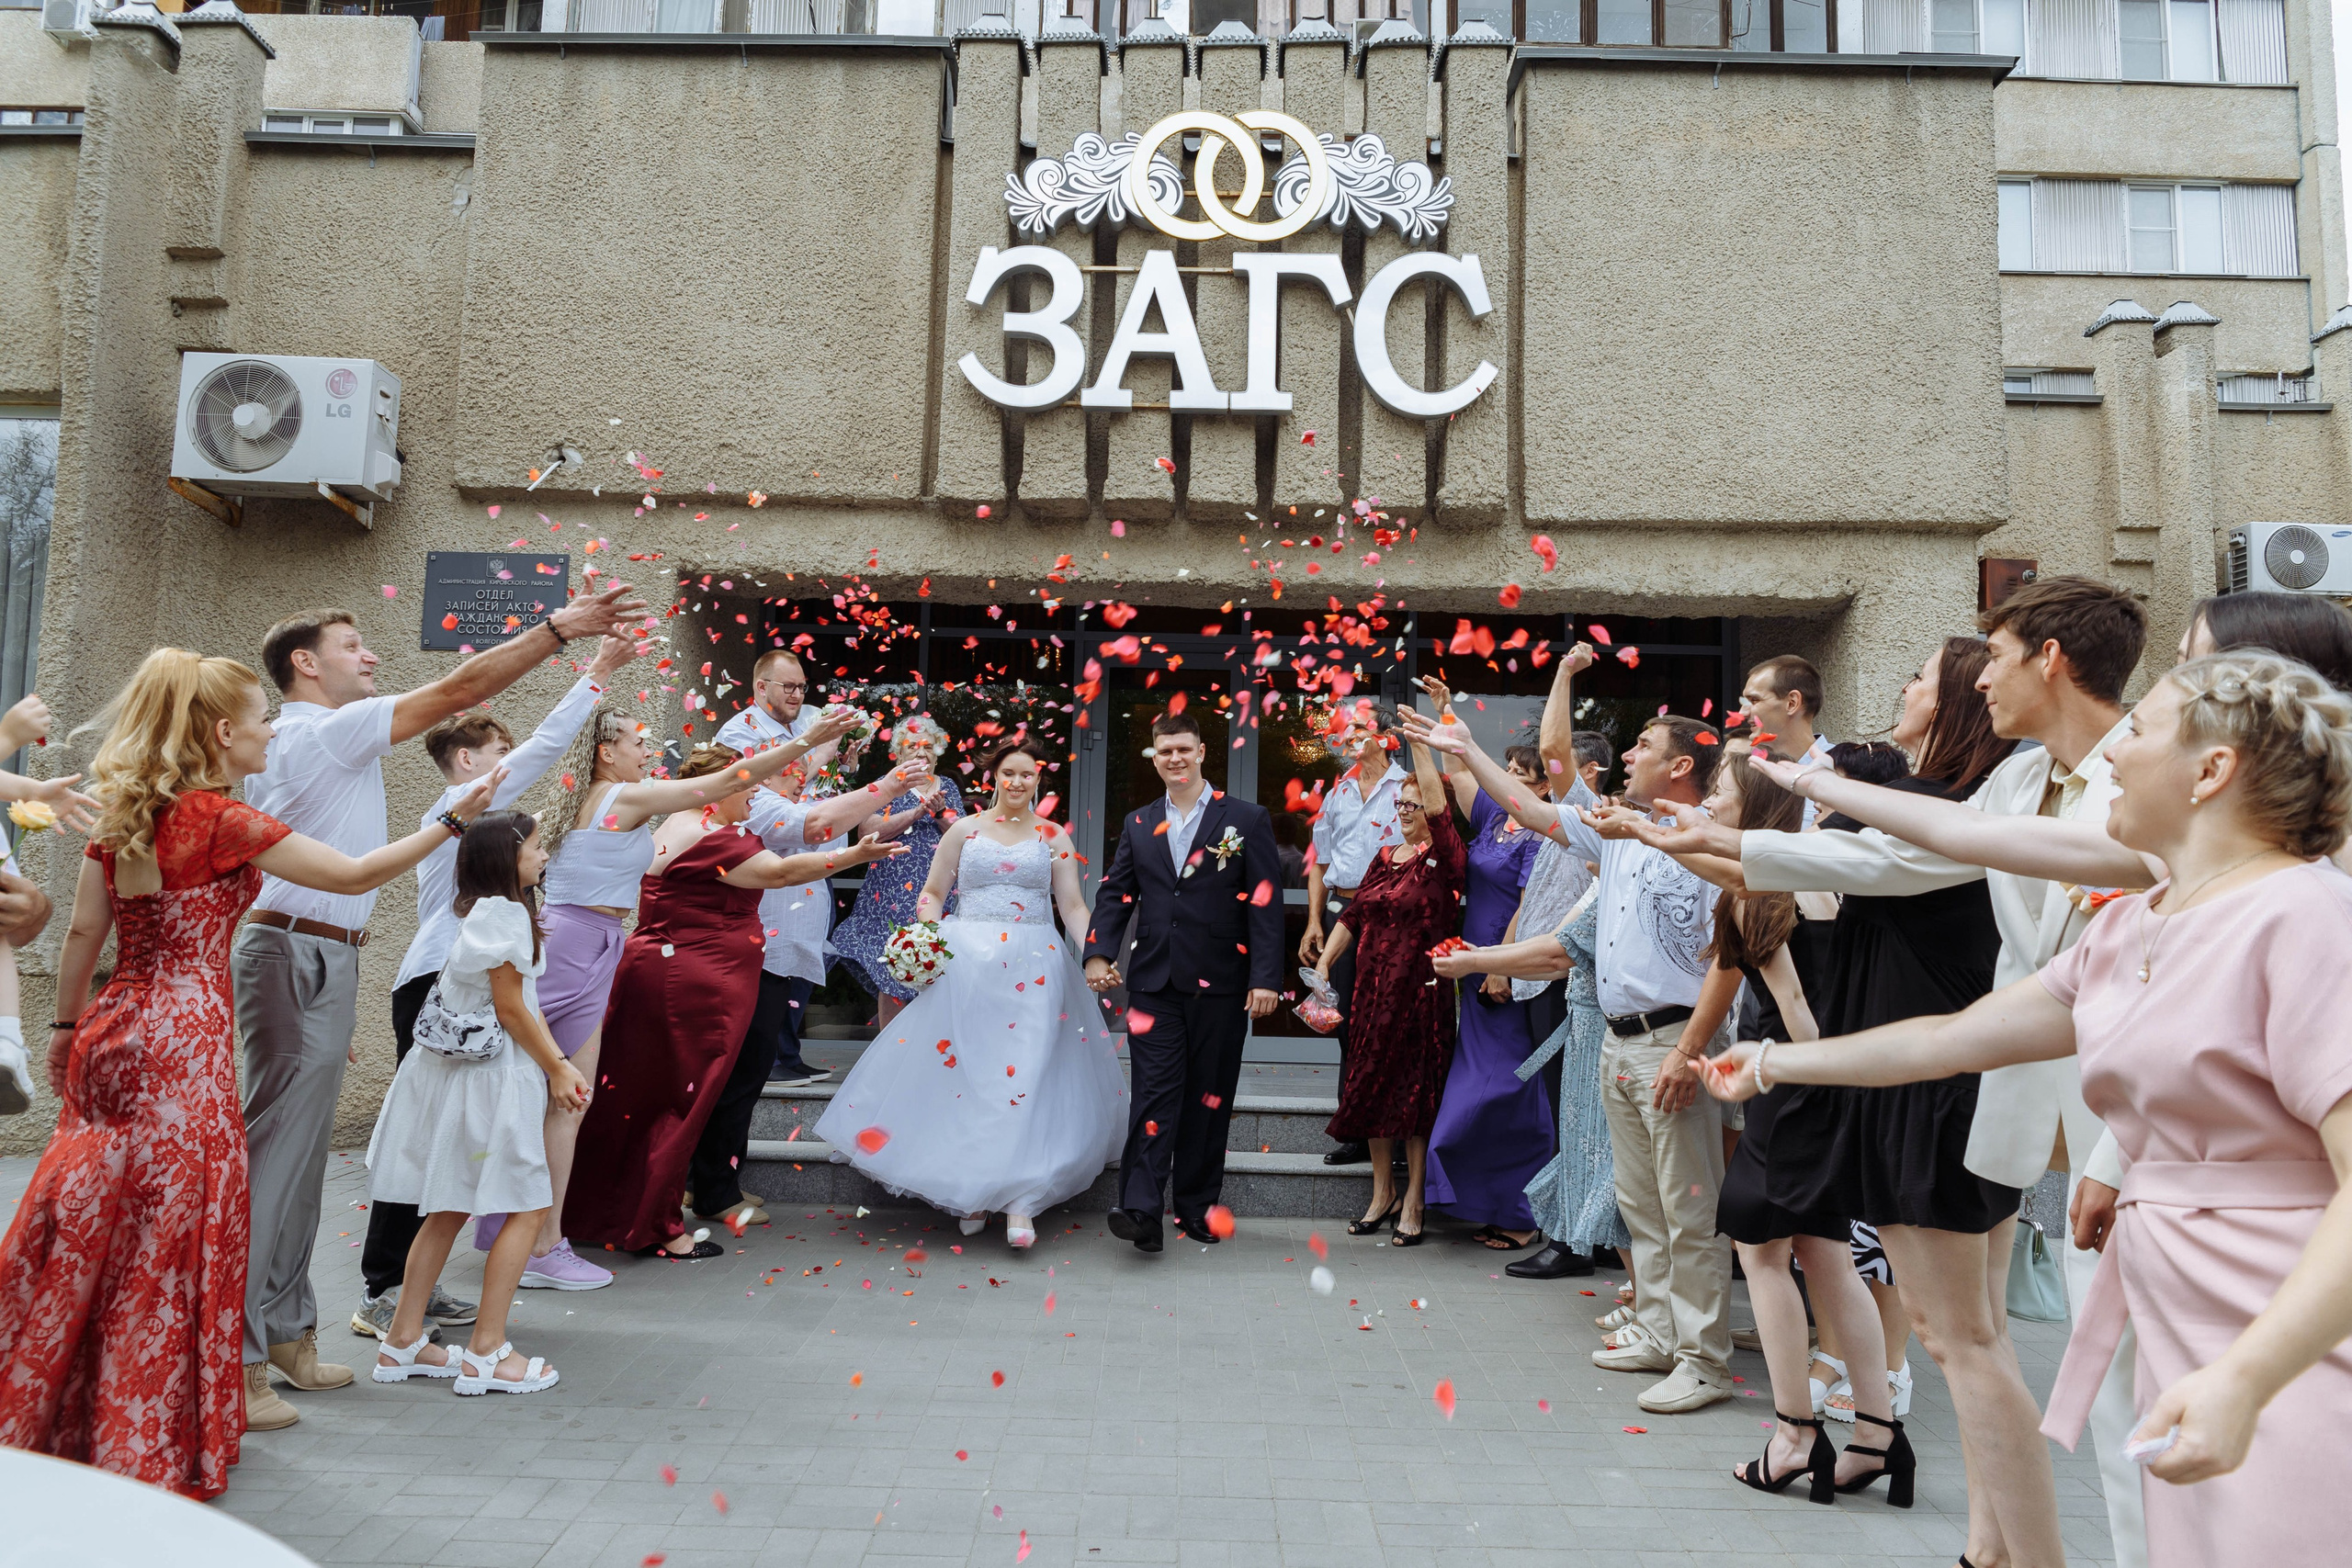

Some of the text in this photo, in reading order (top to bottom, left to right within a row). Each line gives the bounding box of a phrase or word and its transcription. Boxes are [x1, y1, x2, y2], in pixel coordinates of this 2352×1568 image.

[957, 245, 1498, 420] ЗАГС
[325, 403, 352, 418] LG
[475, 589, 514, 600] ОТДЕЛ
[445, 600, 499, 611] ЗАПИСЕЙ
